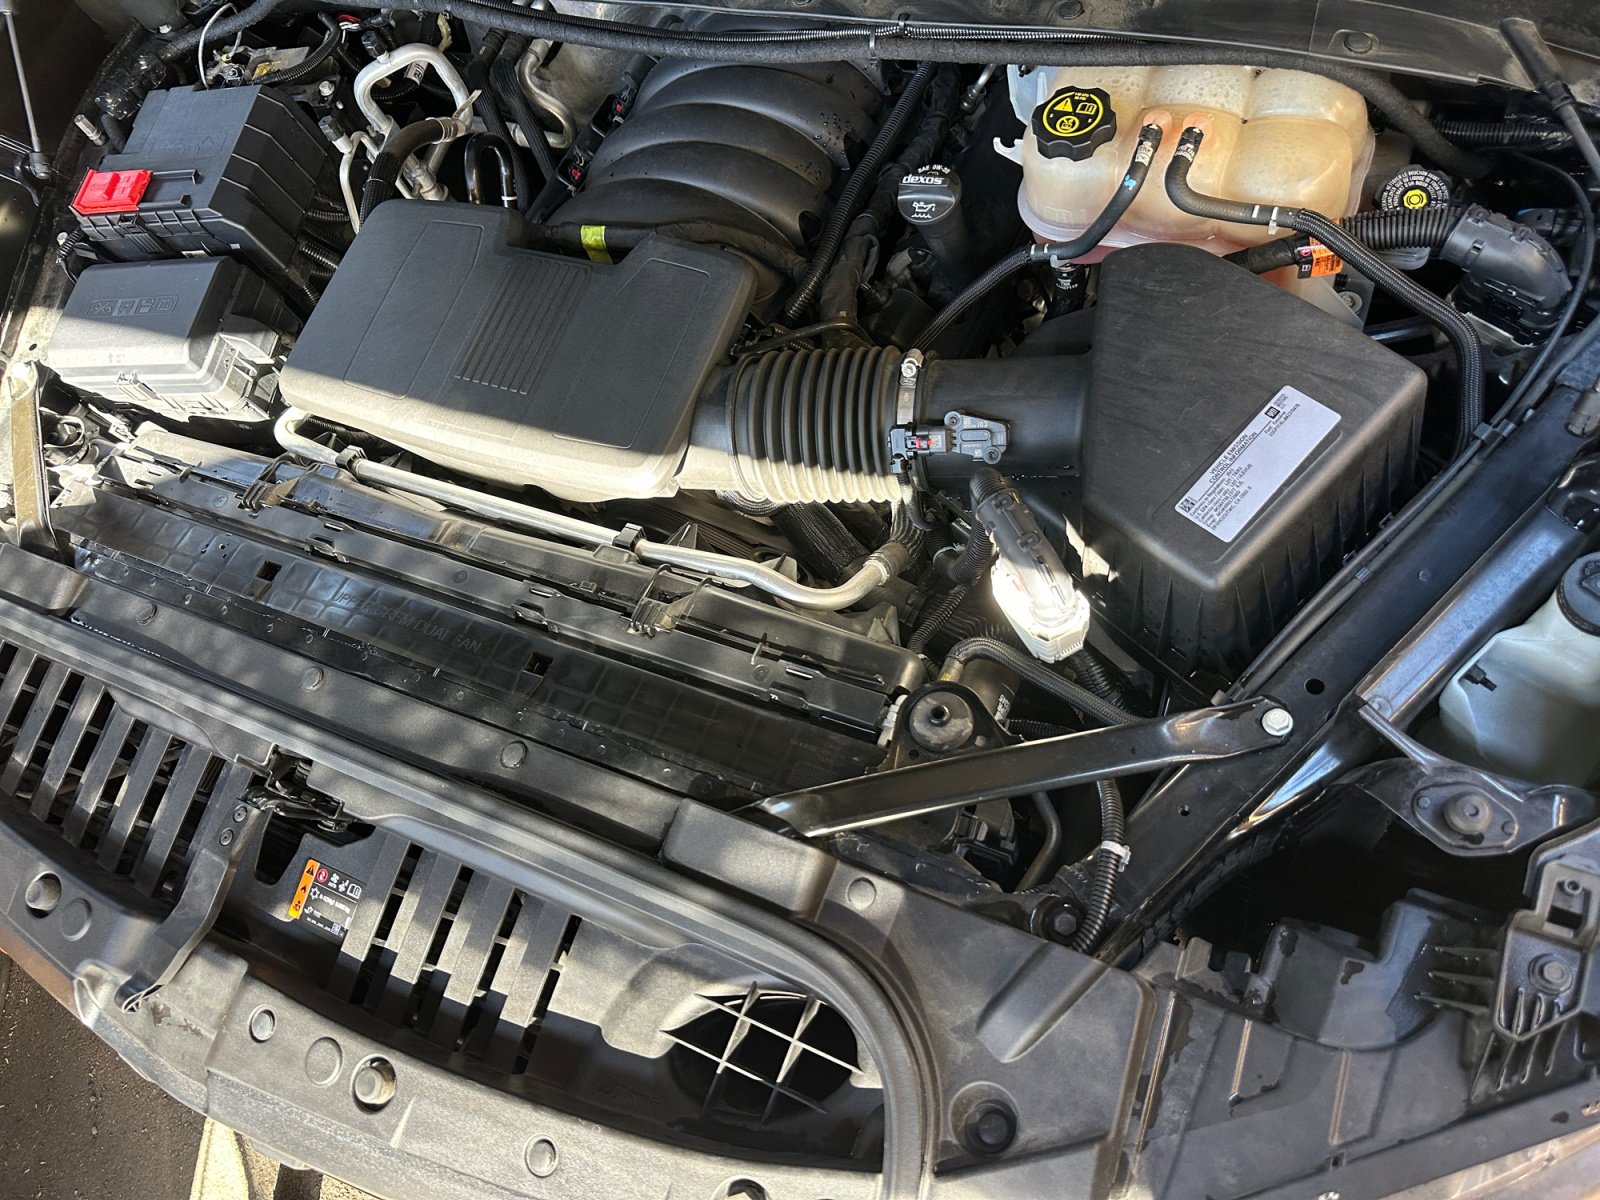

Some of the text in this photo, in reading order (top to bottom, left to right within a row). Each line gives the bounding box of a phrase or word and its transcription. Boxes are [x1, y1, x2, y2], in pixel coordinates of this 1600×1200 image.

[902, 174, 944, 184] dexos
[918, 165, 930, 173] SAE
[1209, 431, 1258, 484] CONTROL INFORMATION
[1210, 433, 1249, 475] VEHICLE EMISSION
[333, 591, 374, 613] UPPER
[450, 632, 483, 654] FAN
